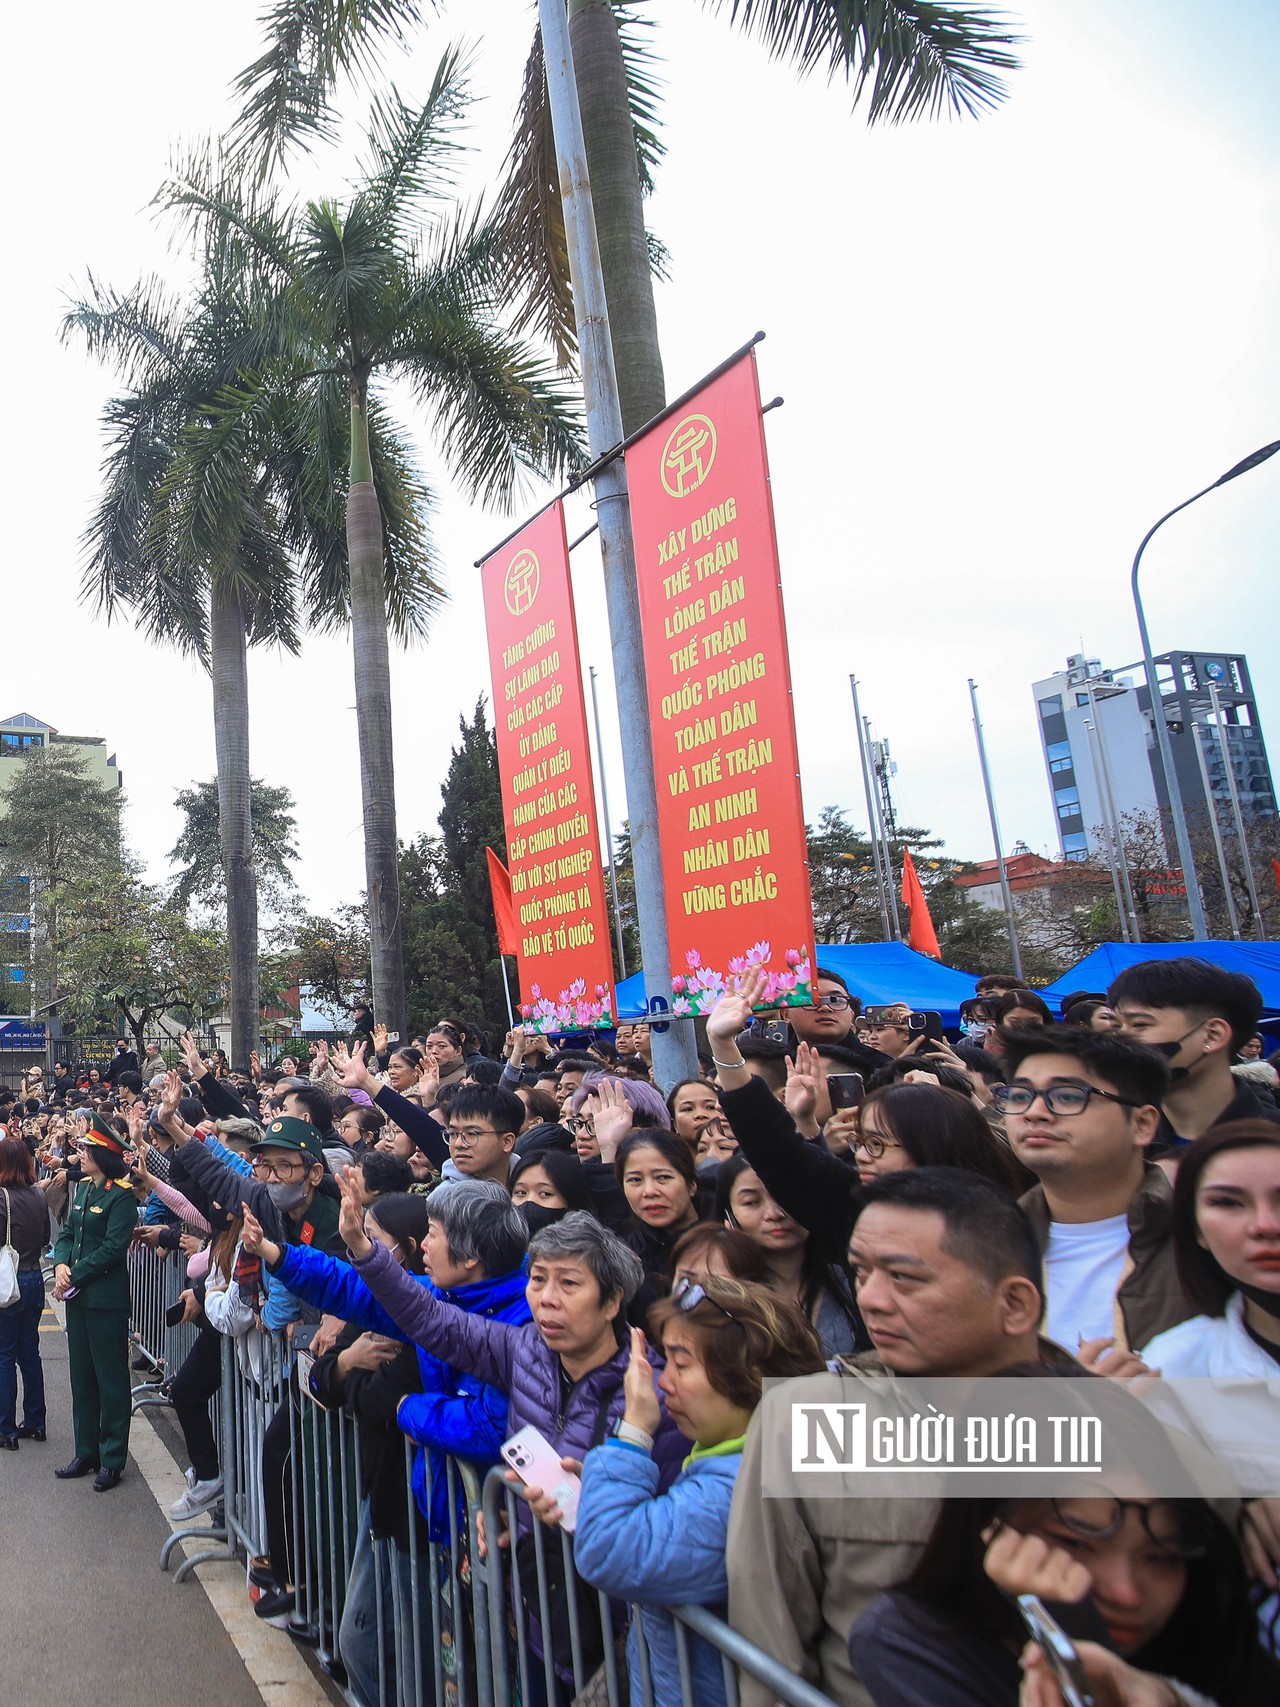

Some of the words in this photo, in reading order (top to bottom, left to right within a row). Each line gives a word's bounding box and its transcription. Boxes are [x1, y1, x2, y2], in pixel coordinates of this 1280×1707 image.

[657, 527, 687, 566] XÂY
[691, 496, 737, 545] DỰNG
[662, 557, 692, 600] THẾ
[694, 536, 740, 574] TRẬN
[664, 598, 706, 640] LÒNG
[709, 575, 745, 616] DÂN
[502, 645, 525, 670] TĂNG
[525, 619, 556, 651] CƯỜNG
[669, 633, 700, 676] THẾ
[701, 617, 748, 655] TRẬN
[504, 678, 517, 702] SỰ
[517, 664, 540, 694] LÃNH
[541, 651, 561, 682] ĐẠO
[661, 677, 703, 720] QUỐC
[707, 652, 766, 700] PHÒNG
[507, 704, 525, 732] CỦA
[525, 694, 544, 721] CÁC
[545, 679, 563, 711] CẤP
[674, 716, 718, 754] TOÀN
[721, 699, 757, 737] DÂN
[519, 731, 531, 759] ỦY
[532, 722, 558, 752] ĐẢNG
[512, 765, 536, 796] QUẢN
[537, 756, 549, 787] LÝ
[549, 746, 572, 778] ĐIỀU
[668, 766, 689, 797] VÀ
[692, 748, 723, 788] THẾ
[725, 737, 773, 777] TRẬN
[513, 799, 537, 828] HÀNH
[538, 788, 557, 817] CỦA
[557, 779, 577, 809] CÁC
[688, 802, 712, 832] AN
[714, 787, 758, 824] NINH
[510, 833, 527, 862] CẤP
[528, 826, 556, 855] CHÍNH
[556, 810, 589, 846] QUYỀN
[683, 839, 729, 875] NHÂN
[733, 828, 770, 862] DÂN
[511, 866, 527, 894] ĐỐI
[527, 863, 543, 889] VỚI
[544, 859, 557, 886] SỰ
[558, 847, 593, 880] NGHIỆP
[682, 884, 727, 916] VỮNG
[730, 866, 778, 906] CHẮC
[520, 894, 544, 926] QUỐC
[544, 890, 577, 919] PHÒNG
[577, 882, 592, 910] VÀ
[522, 930, 540, 958] BẢO
[541, 927, 554, 957] VỆ
[554, 920, 567, 951] TỔ
[568, 916, 595, 950] QUỐC
